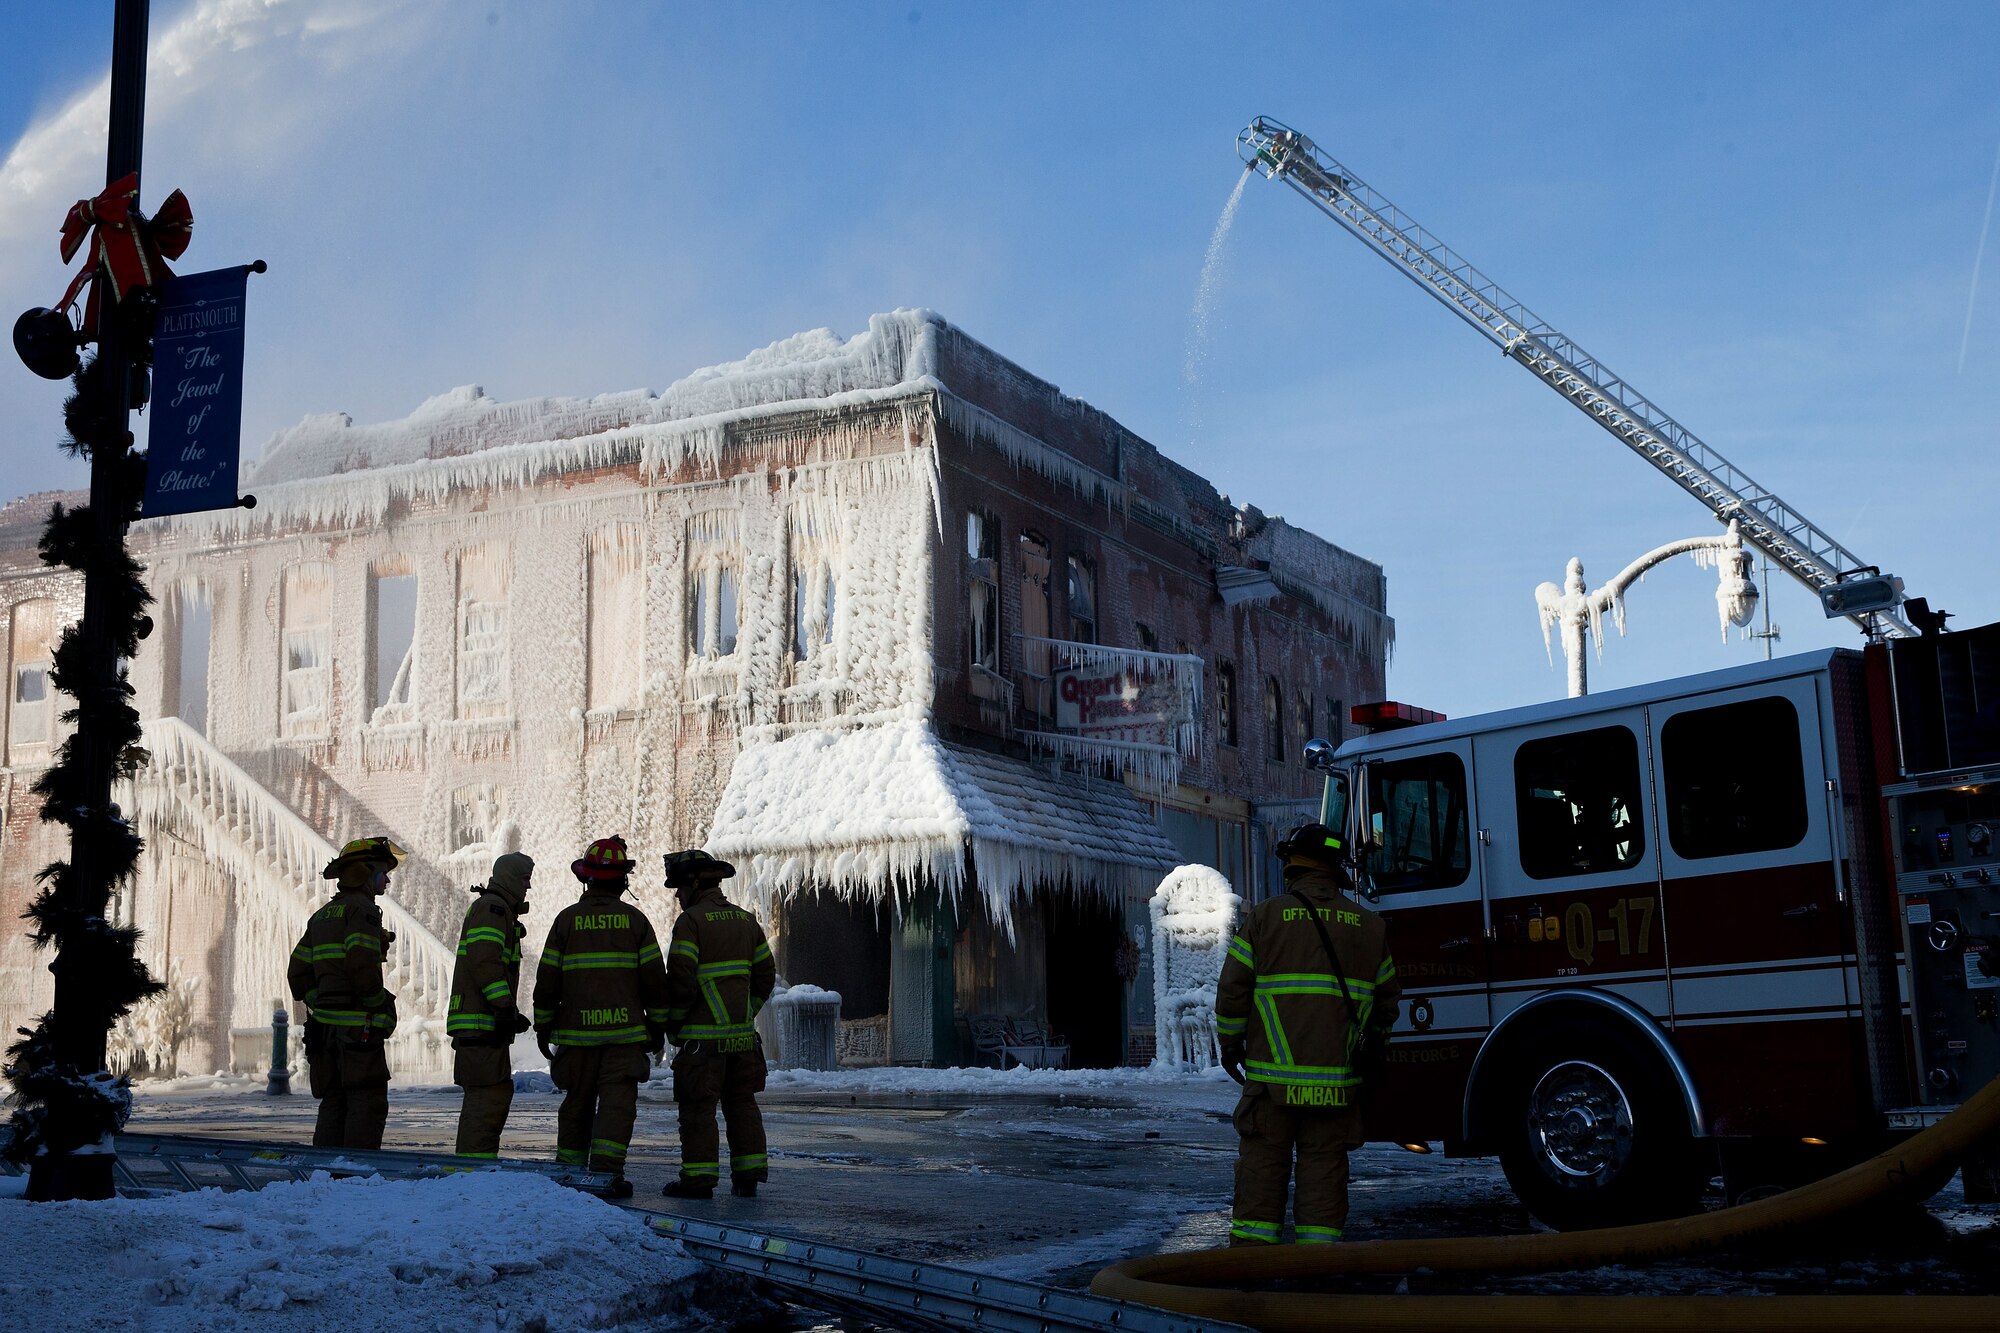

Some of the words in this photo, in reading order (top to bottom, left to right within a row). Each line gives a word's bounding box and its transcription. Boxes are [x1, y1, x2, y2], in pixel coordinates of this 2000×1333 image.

[163, 306, 238, 333] PLATTSMOUTH
[171, 373, 224, 408] Jewel
[187, 404, 211, 435] of
[180, 441, 206, 462] the
[575, 913, 631, 930] RALSTON
[704, 910, 734, 922] OFFUTT
[1336, 909, 1361, 927] FIRE
[1565, 896, 1655, 967] Q-17
[1420, 961, 1475, 979] STATES
[580, 1008, 629, 1026] THOMAS
[1410, 1044, 1459, 1063] FORCE
[1286, 1085, 1349, 1106] KIMBALL
